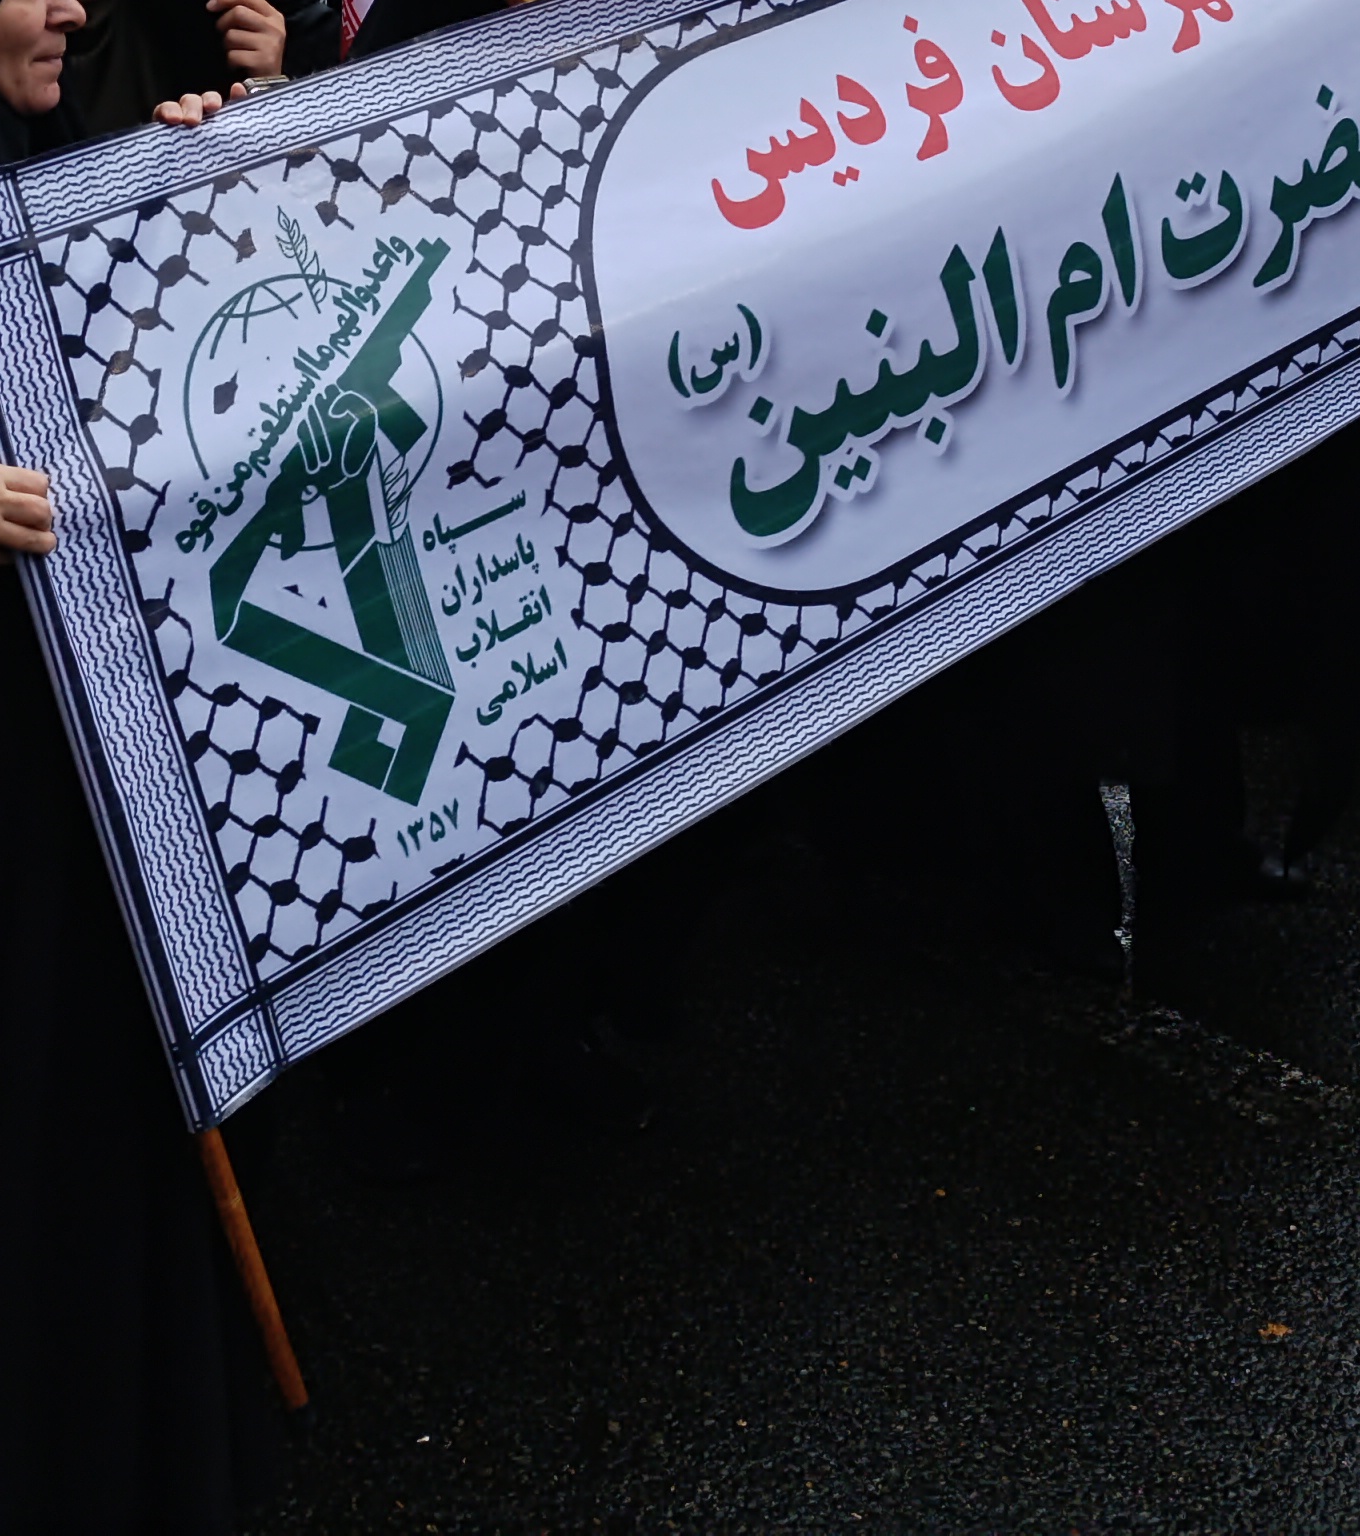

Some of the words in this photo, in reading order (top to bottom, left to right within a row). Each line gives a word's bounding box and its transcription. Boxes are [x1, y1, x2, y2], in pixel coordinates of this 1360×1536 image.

[710, 15, 965, 231] فردیس
[1046, 173, 1135, 389] ام
[667, 303, 765, 399] (س)
[729, 226, 1022, 537] البنین
[422, 489, 526, 555] سپاه
[440, 532, 540, 616] پاسداران
[454, 584, 553, 669] انقلاب
[475, 637, 568, 727] اسلامی
[395, 797, 460, 859] ۱۳۵۷
